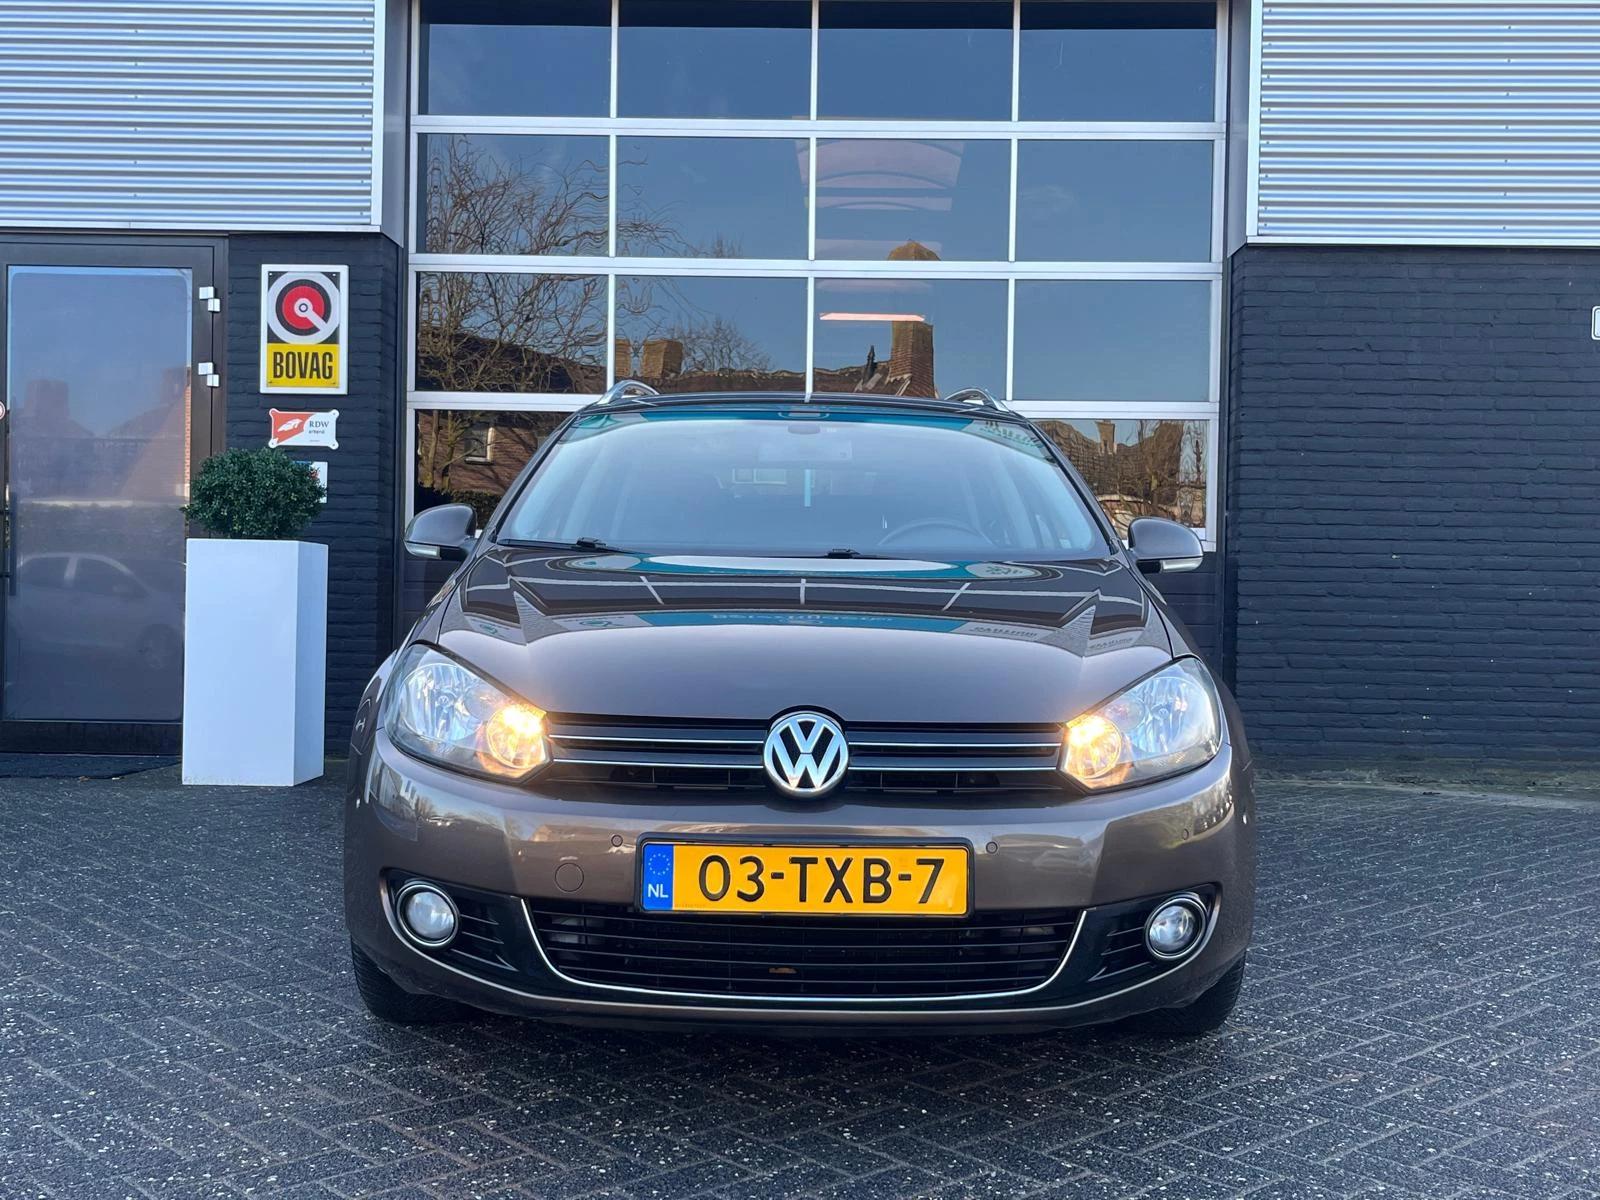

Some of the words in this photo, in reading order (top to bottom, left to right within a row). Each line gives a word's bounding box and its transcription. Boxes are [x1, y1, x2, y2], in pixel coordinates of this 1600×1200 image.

[273, 351, 333, 379] BOVAG
[309, 420, 330, 428] RDW
[698, 854, 946, 904] 03-TXB-7
[647, 883, 669, 898] NL
